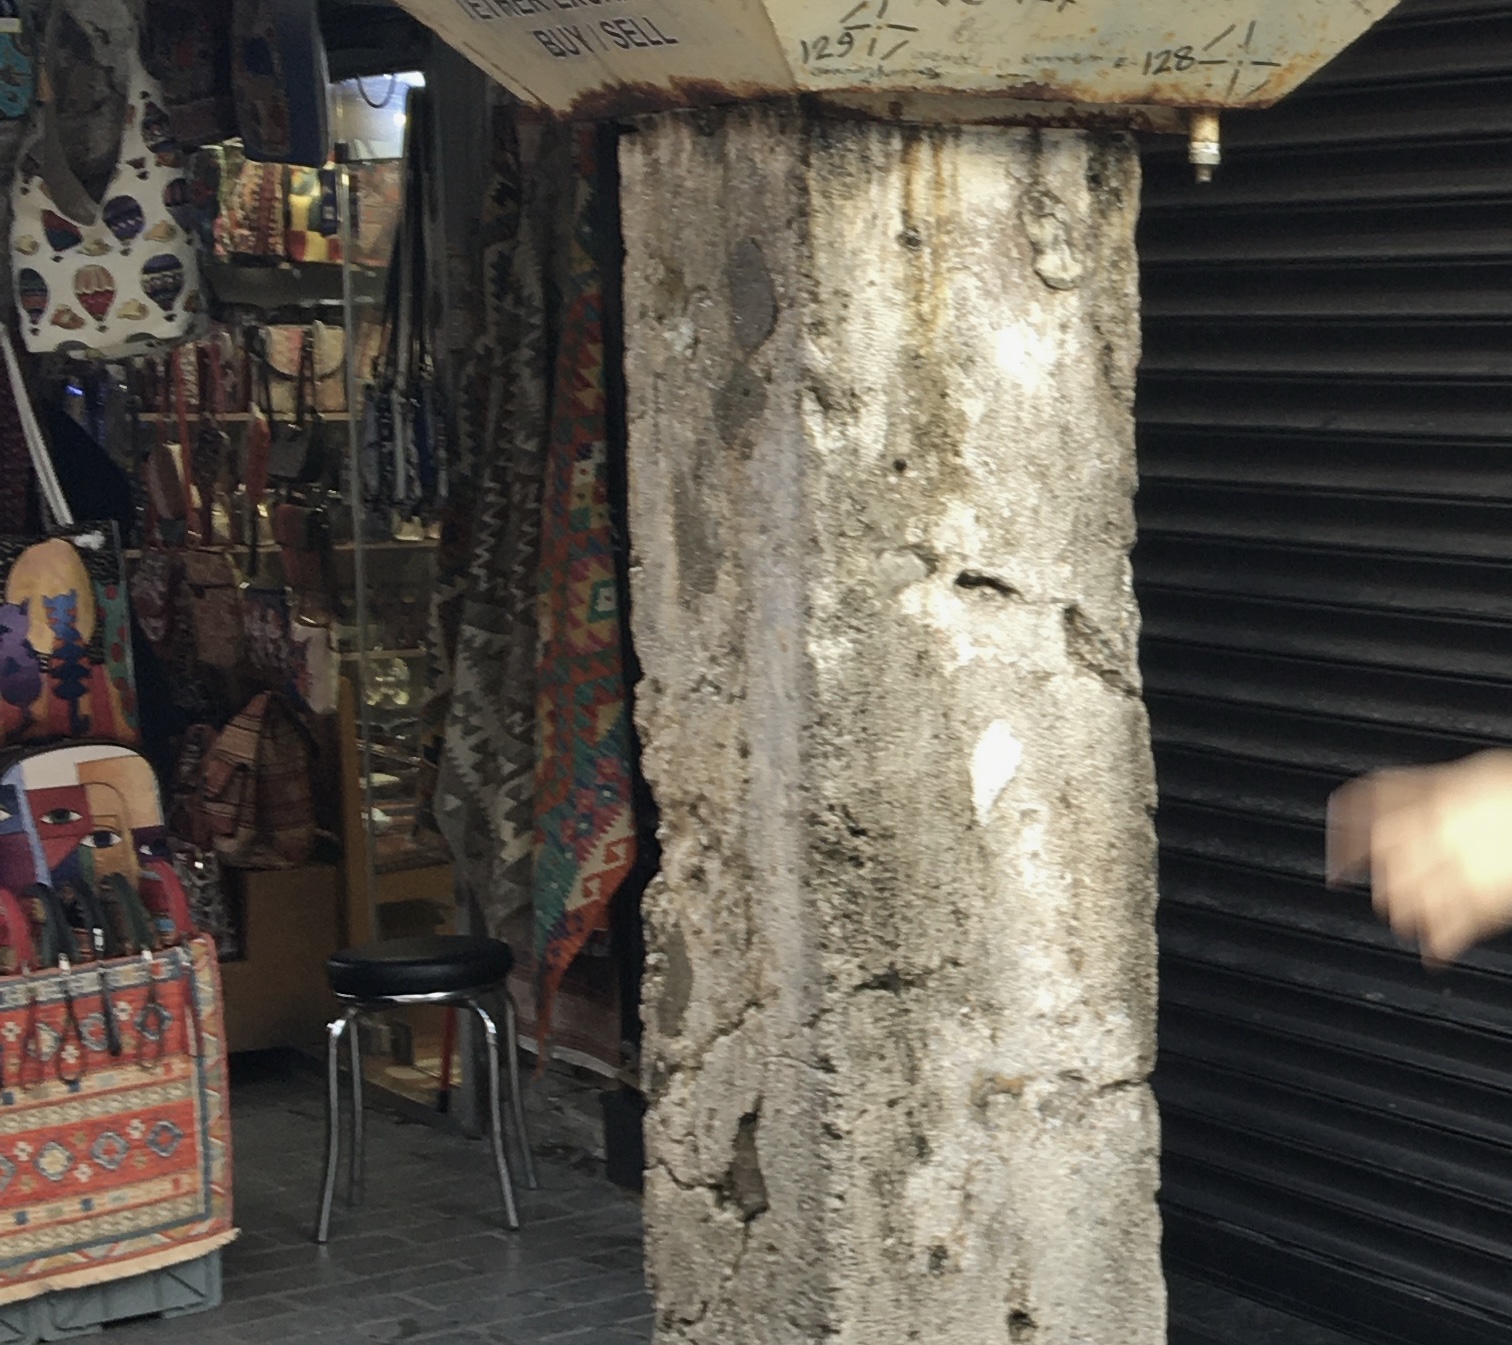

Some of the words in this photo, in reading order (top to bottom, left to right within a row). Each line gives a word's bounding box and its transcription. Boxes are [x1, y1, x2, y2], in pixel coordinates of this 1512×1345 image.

[532, 24, 595, 59] BUY
[599, 16, 680, 50] SELL
[800, 31, 855, 65] 129
[1142, 45, 1197, 77] 128
